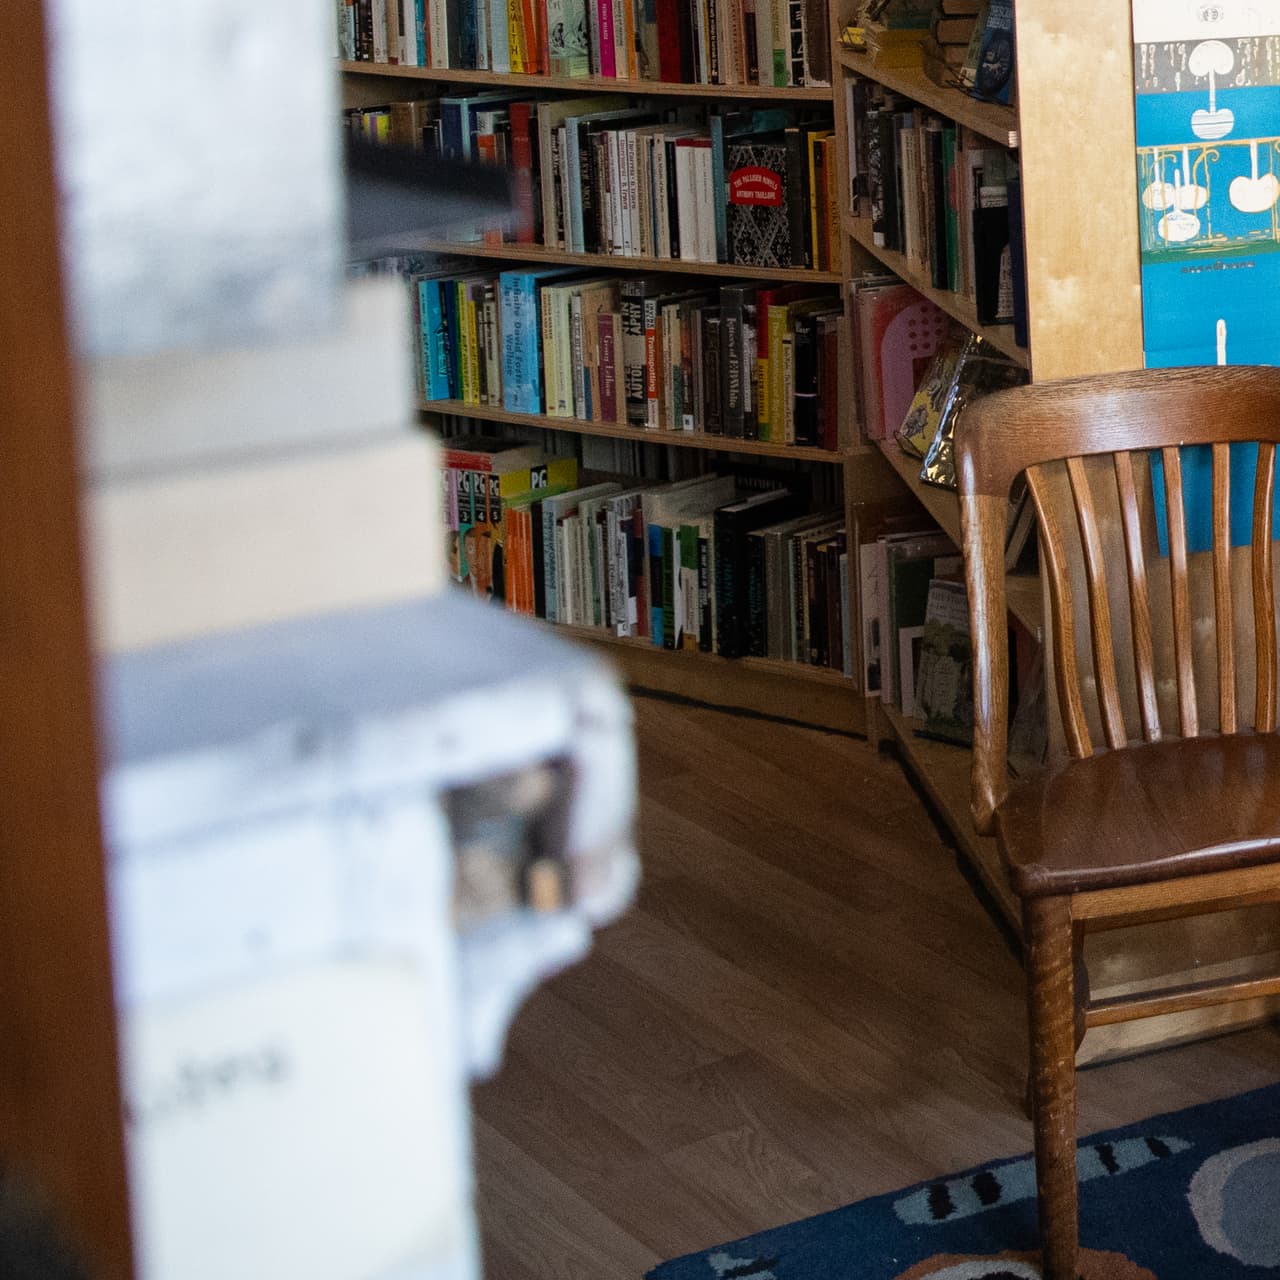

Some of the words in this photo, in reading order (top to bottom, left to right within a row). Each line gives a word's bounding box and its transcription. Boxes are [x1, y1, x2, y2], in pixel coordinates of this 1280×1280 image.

[509, 3, 519, 56] SMITH
[736, 191, 754, 199] ANTHONY
[755, 191, 776, 200] TROLLOPE
[504, 282, 512, 305] Jest
[647, 334, 656, 394] Trainspotting
[457, 471, 469, 492] PG
[474, 471, 486, 492] PG
[488, 473, 501, 493] PG
[531, 468, 548, 490] PG
